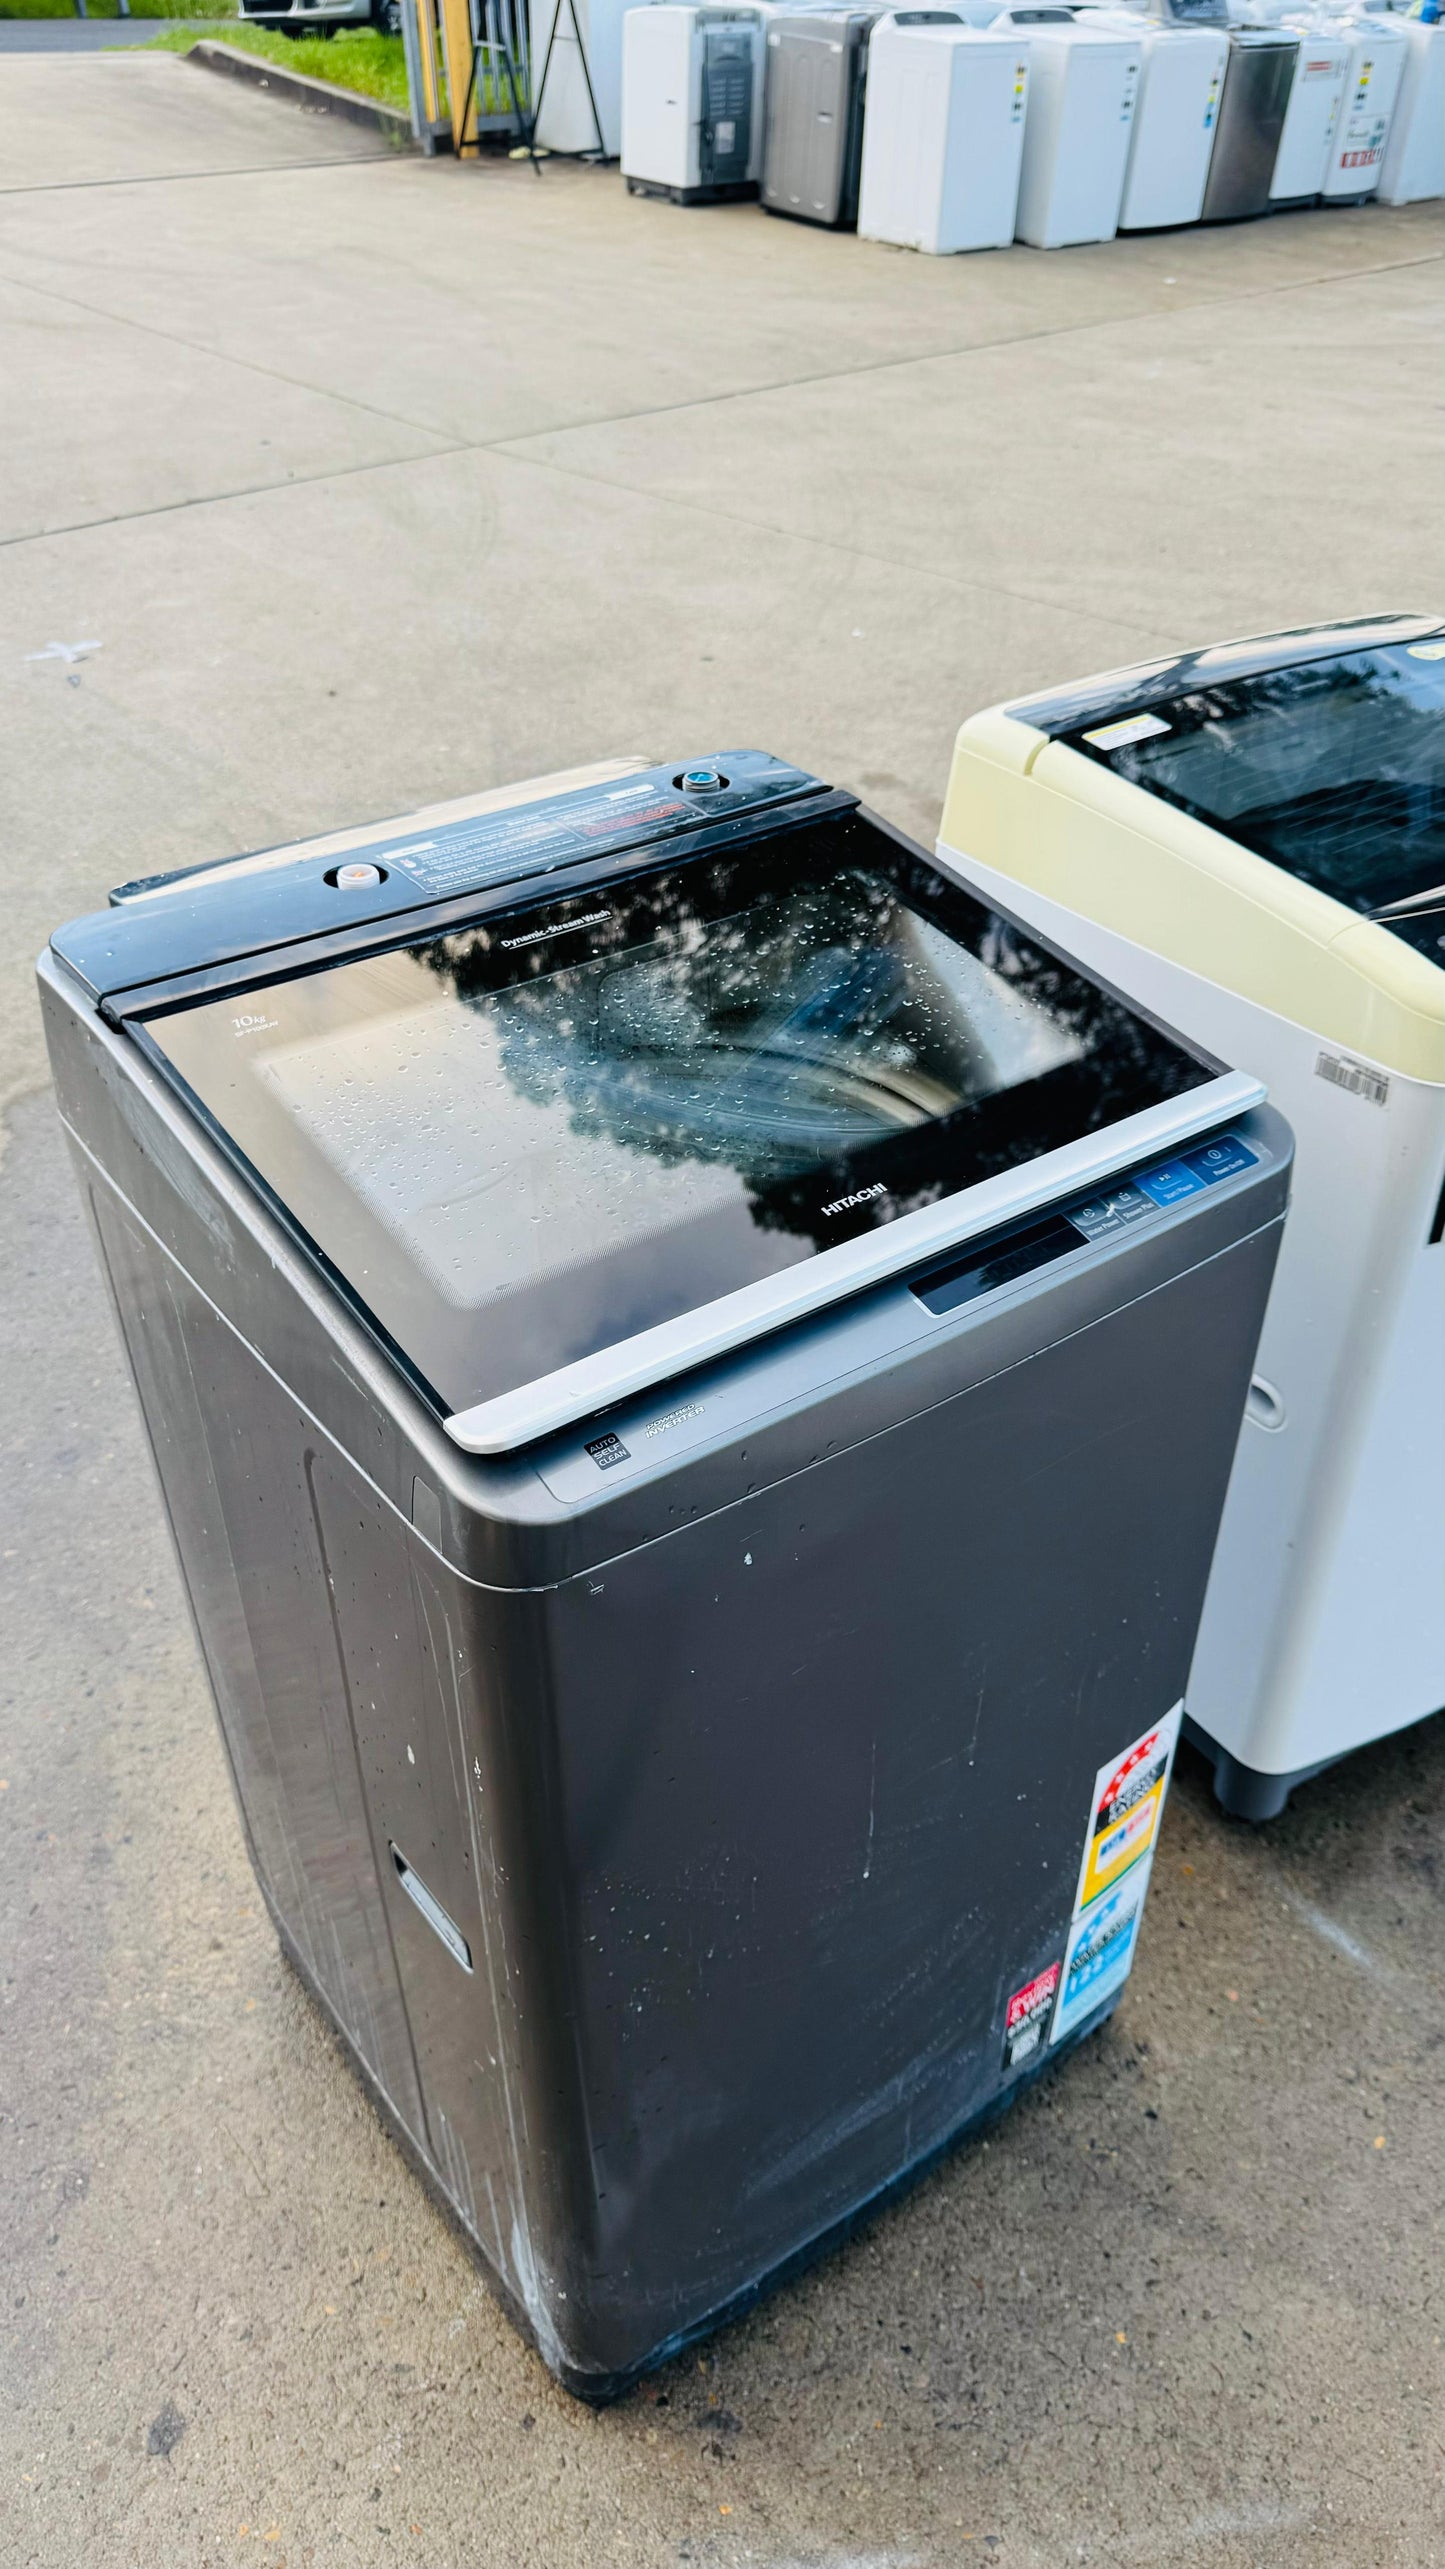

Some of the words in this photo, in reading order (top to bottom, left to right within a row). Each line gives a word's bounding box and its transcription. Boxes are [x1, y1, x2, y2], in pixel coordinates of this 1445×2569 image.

[500, 917, 584, 948] Dynamic-Stream
[582, 909, 612, 924] Wash
[820, 1182, 888, 1217] HITACHI
[645, 1403, 696, 1430] POWERED
[645, 1406, 705, 1439] INVERTER
[590, 1436, 617, 1454] AUTO
[593, 1442, 621, 1460] SELF
[598, 1449, 627, 1467] CLEAN
